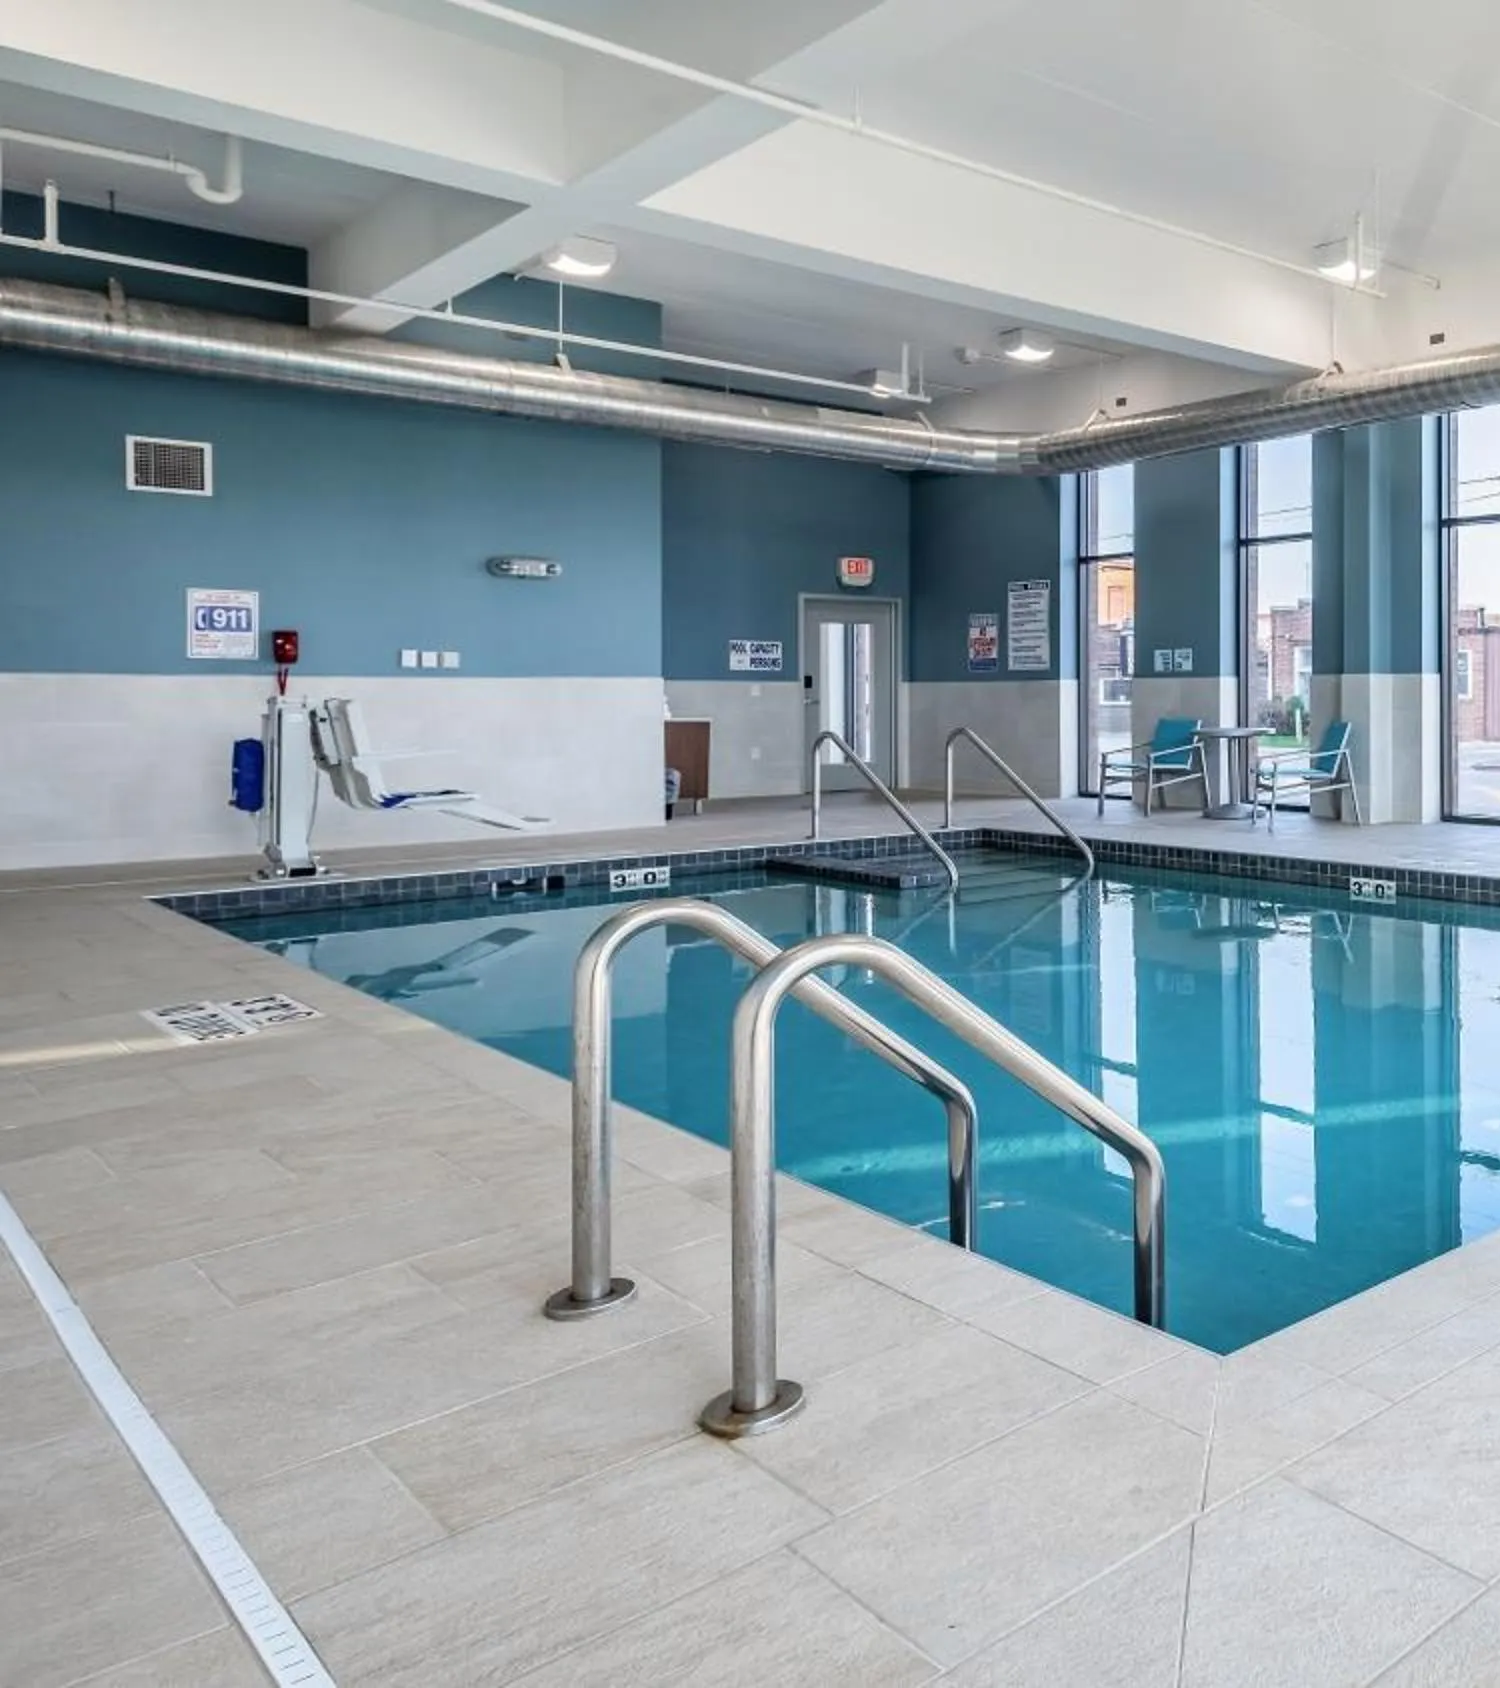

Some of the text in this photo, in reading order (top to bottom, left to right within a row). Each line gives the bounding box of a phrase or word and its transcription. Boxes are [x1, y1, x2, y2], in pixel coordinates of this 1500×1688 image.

[212, 607, 247, 629] 911
[613, 873, 627, 888] 3
[1352, 881, 1362, 896] 3
